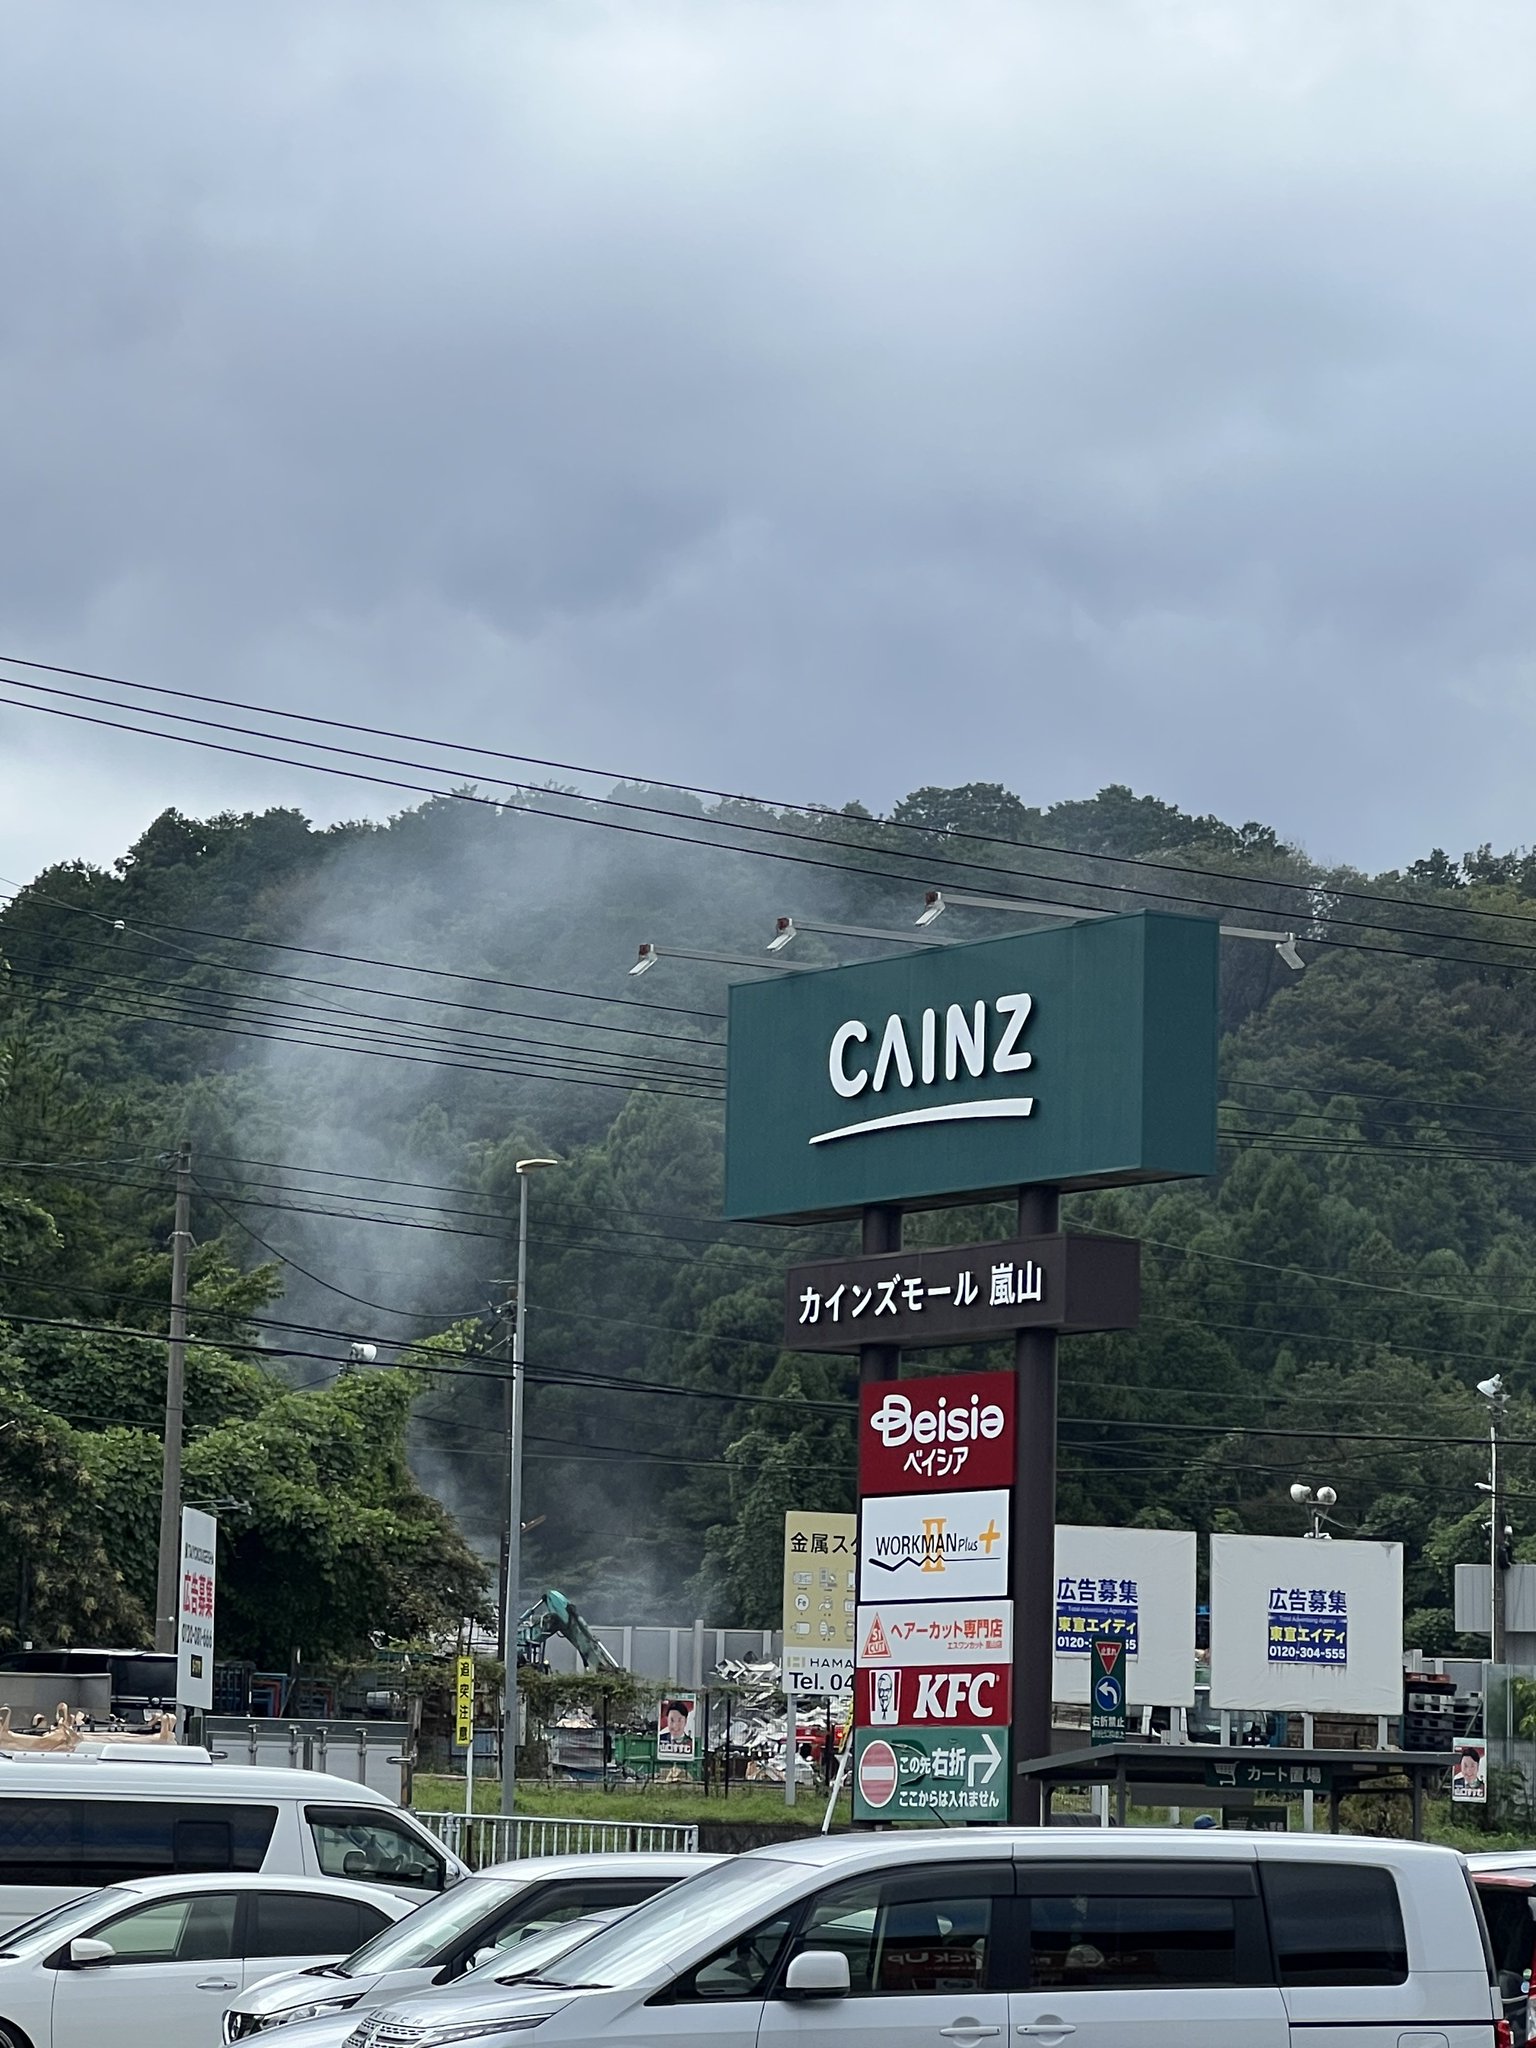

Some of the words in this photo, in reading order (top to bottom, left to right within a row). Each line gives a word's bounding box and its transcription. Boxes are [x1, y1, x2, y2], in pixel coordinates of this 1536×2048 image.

[829, 992, 1033, 1098] CAINZ
[798, 1270, 979, 1325] カインズモール
[988, 1259, 1044, 1308] 嵐山
[870, 1393, 1005, 1448] Beisia
[903, 1446, 969, 1477] ベイシア
[876, 1532, 957, 1556] WORKMAN
[958, 1535, 979, 1552] Plus
[183, 1570, 213, 1619] 広告募集
[1057, 1577, 1138, 1604] 広告募集
[1269, 1587, 1347, 1613] 広告募集
[891, 1619, 1003, 1640] ヘアーカット専門店
[869, 1642, 884, 1653] CUT
[1269, 1645, 1346, 1659] 0120-304-555
[788, 1672, 824, 1691] Tel.
[459, 1662, 470, 1741] 追突注意
[912, 1672, 996, 1719] KFC
[1247, 1765, 1321, 1784] カート置場
[899, 1791, 999, 1808] ここからは入れません
